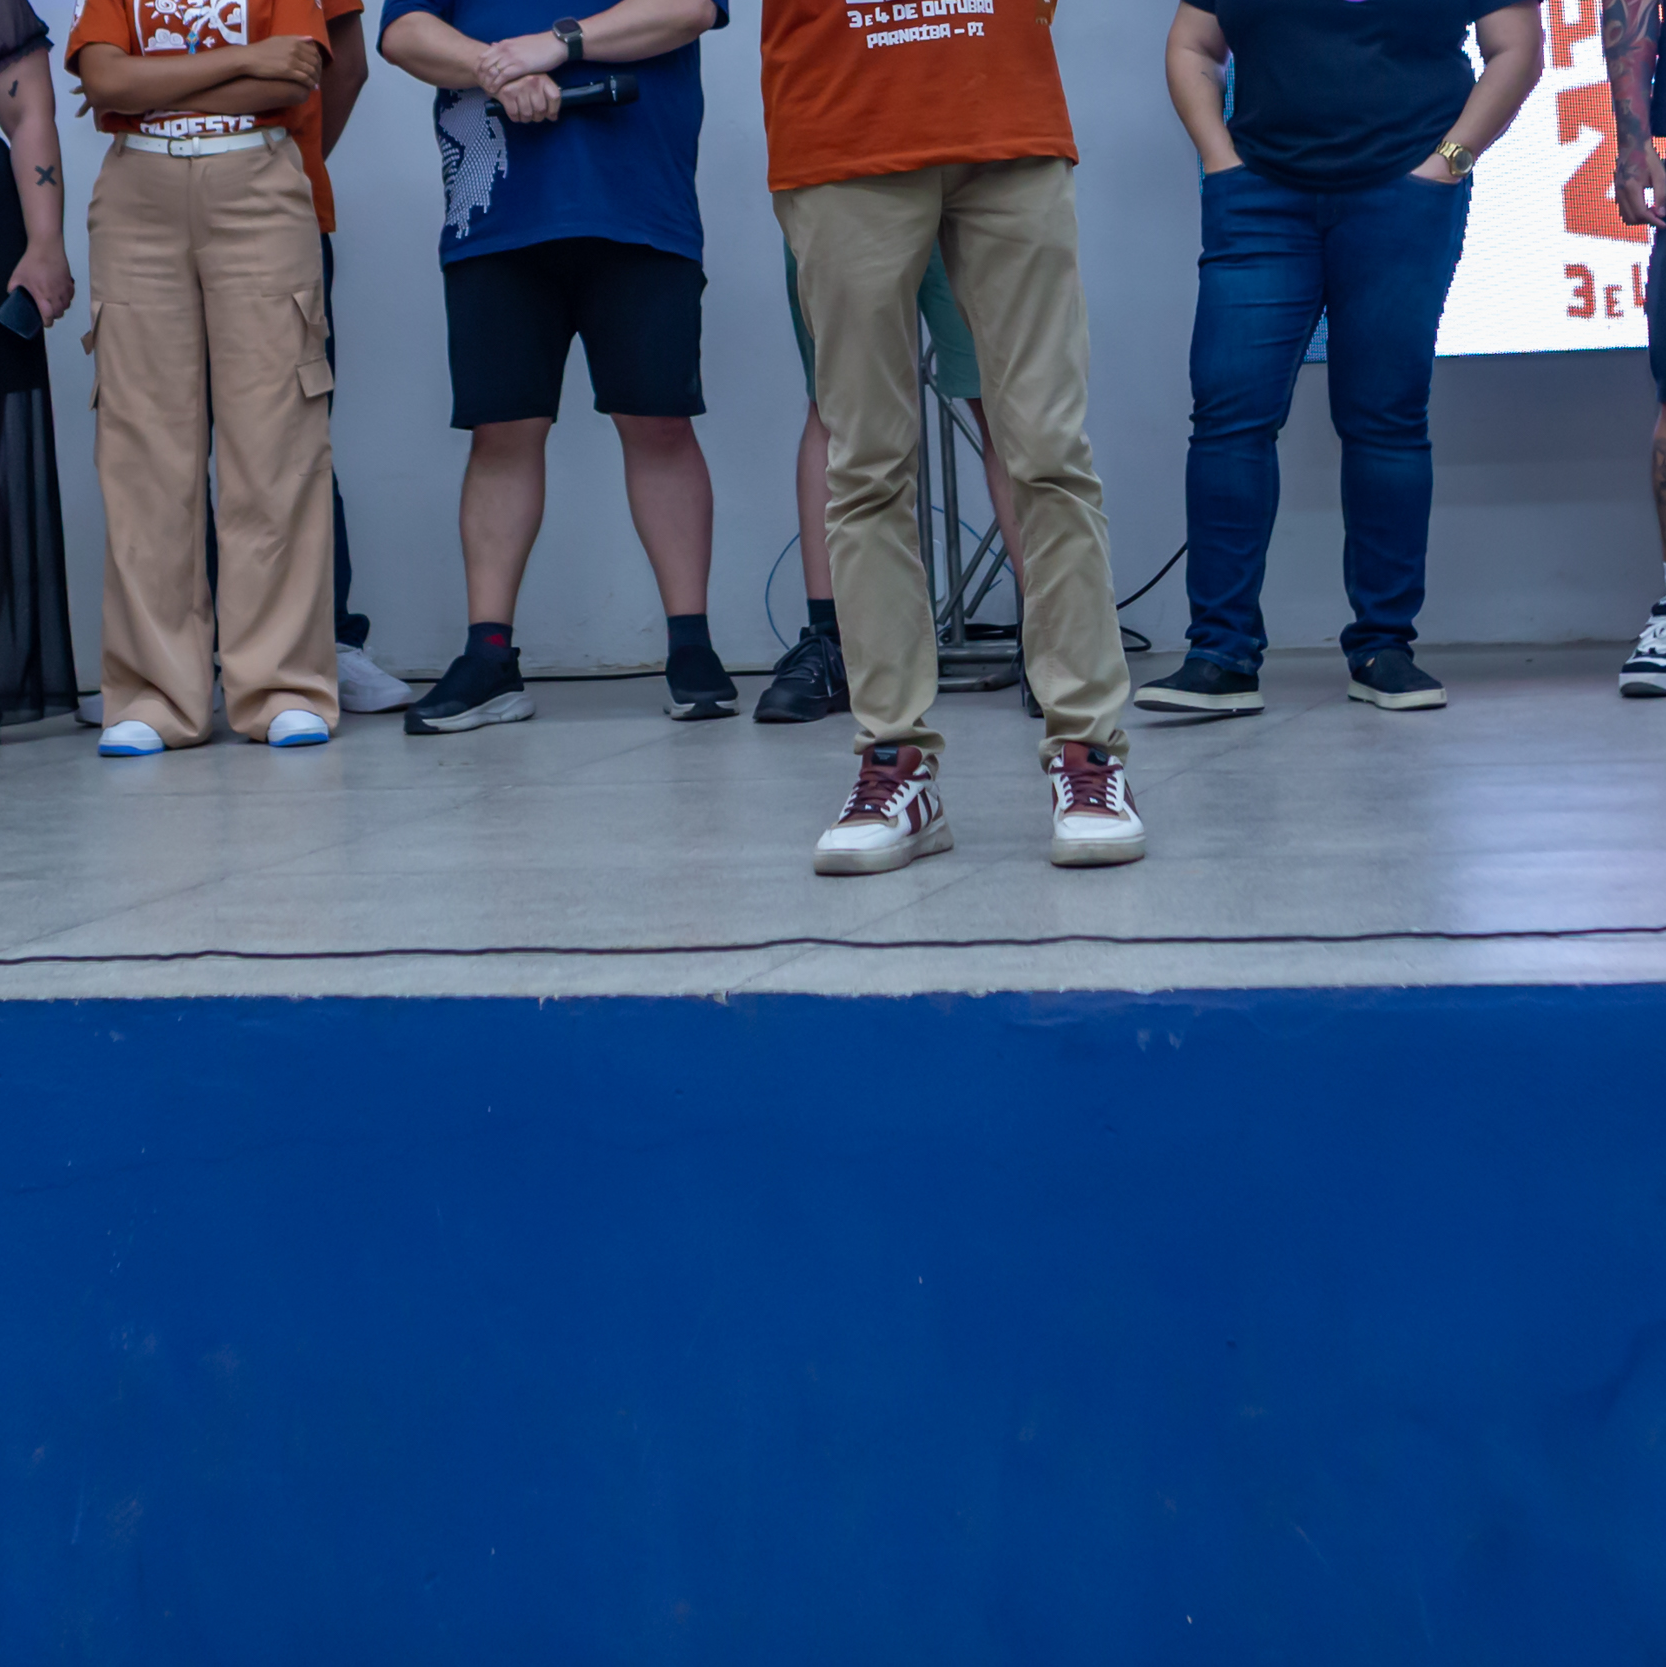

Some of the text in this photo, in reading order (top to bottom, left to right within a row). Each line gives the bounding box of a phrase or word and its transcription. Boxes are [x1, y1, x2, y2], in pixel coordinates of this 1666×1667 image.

[847, 10, 863, 28] 3
[864, 14, 873, 26] E
[875, 7, 890, 23] 4
[892, 3, 918, 21] DE
[866, 23, 951, 49] PARNAÍBA
[967, 22, 985, 37] PI
